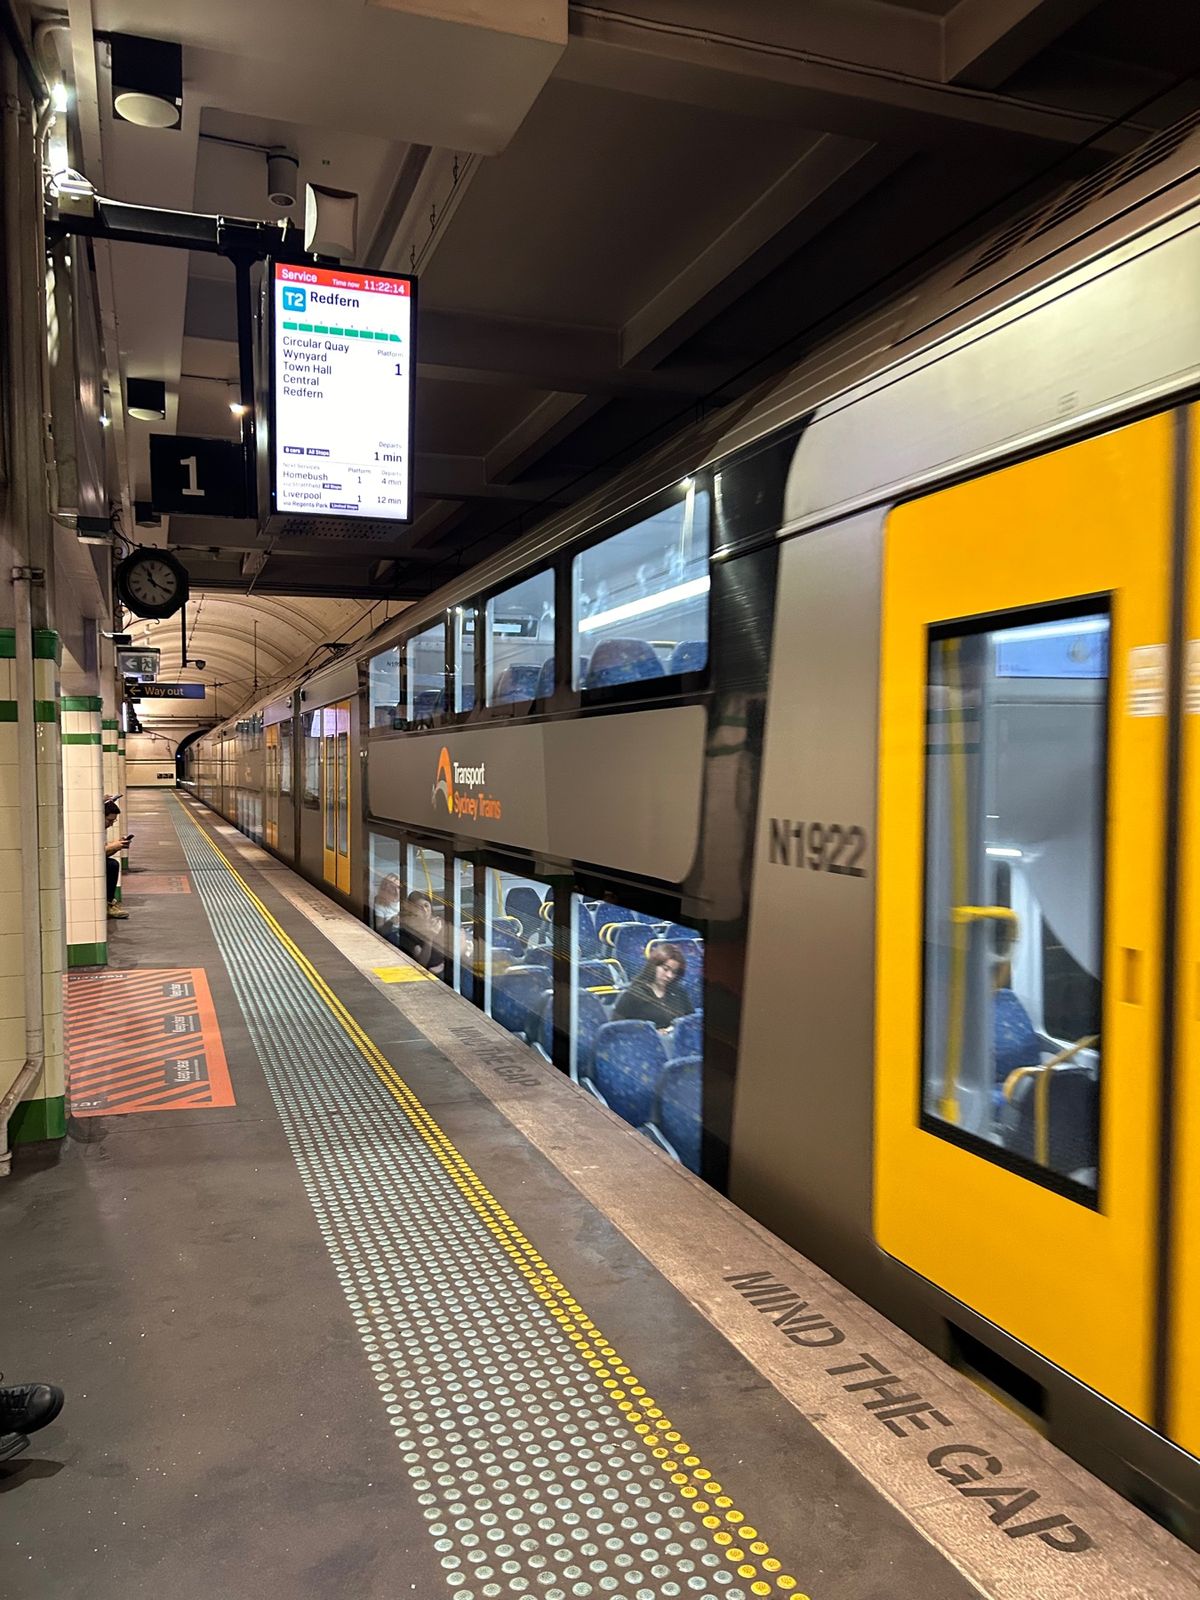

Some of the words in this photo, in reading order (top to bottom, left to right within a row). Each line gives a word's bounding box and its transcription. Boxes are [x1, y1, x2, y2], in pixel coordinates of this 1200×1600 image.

[281, 269, 318, 283] Service
[332, 278, 347, 287] Time
[348, 281, 360, 289] now
[364, 280, 405, 294] 11:22:14
[285, 292, 304, 307] T2
[310, 291, 360, 308] Redfern
[283, 336, 322, 349] Circular
[325, 340, 350, 354] Quay
[283, 349, 328, 362] Wynyard
[377, 349, 403, 358] Platform
[283, 361, 311, 373] Town
[313, 364, 332, 375] Hall
[394, 363, 403, 376] 1
[283, 374, 320, 386] Central
[283, 386, 323, 399] Redfern
[378, 441, 402, 449] Departs
[374, 451, 380, 461] 1
[383, 452, 402, 462] min
[180, 455, 206, 497] 1
[283, 471, 328, 481] Homebush
[357, 476, 362, 484] 1
[283, 490, 322, 500] Liverpool
[357, 494, 362, 503] 1
[377, 496, 387, 504] 12
[292, 500, 315, 508] Regents
[144, 686, 166, 696] Way
[167, 686, 184, 696] out
[453, 762, 485, 789] Transport
[453, 791, 478, 821] Sydney
[478, 793, 502, 819] Trains
[768, 817, 868, 878] N1922
[493, 1066, 542, 1087] GAP
[722, 1270, 846, 1349] MIND
[825, 1352, 953, 1438] THE
[926, 1443, 1097, 1553] GAP
